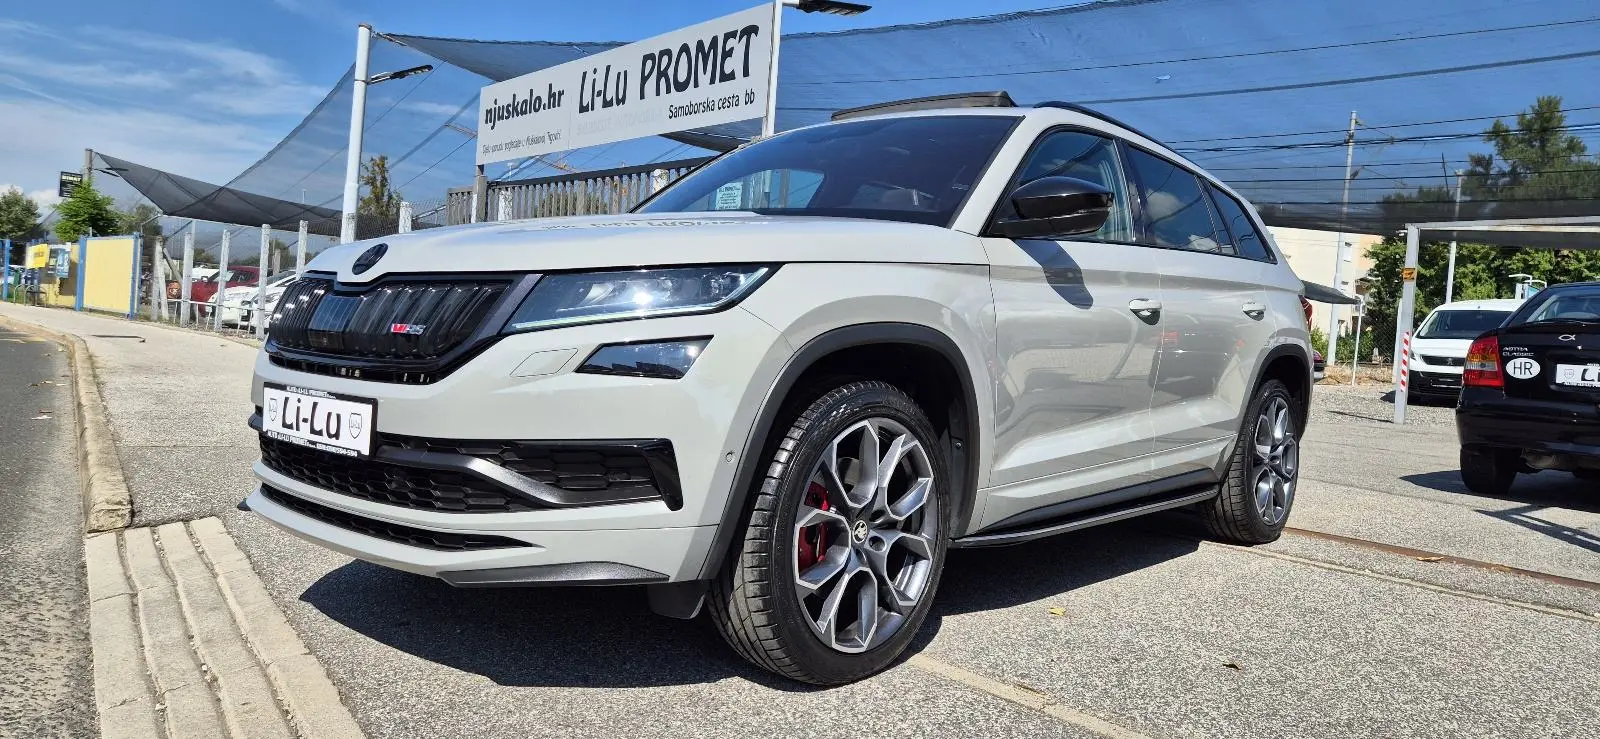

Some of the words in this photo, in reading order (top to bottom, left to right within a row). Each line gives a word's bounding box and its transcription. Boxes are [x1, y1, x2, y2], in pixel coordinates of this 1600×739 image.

[579, 64, 628, 114] Li-Lu
[639, 24, 760, 100] PROMET
[484, 83, 565, 130] njuskalo.hr
[668, 97, 715, 120] Samoborska
[717, 93, 740, 111] cesta
[744, 88, 755, 106] bb
[1513, 361, 1533, 376] HR
[281, 396, 342, 440] Li-Lu
